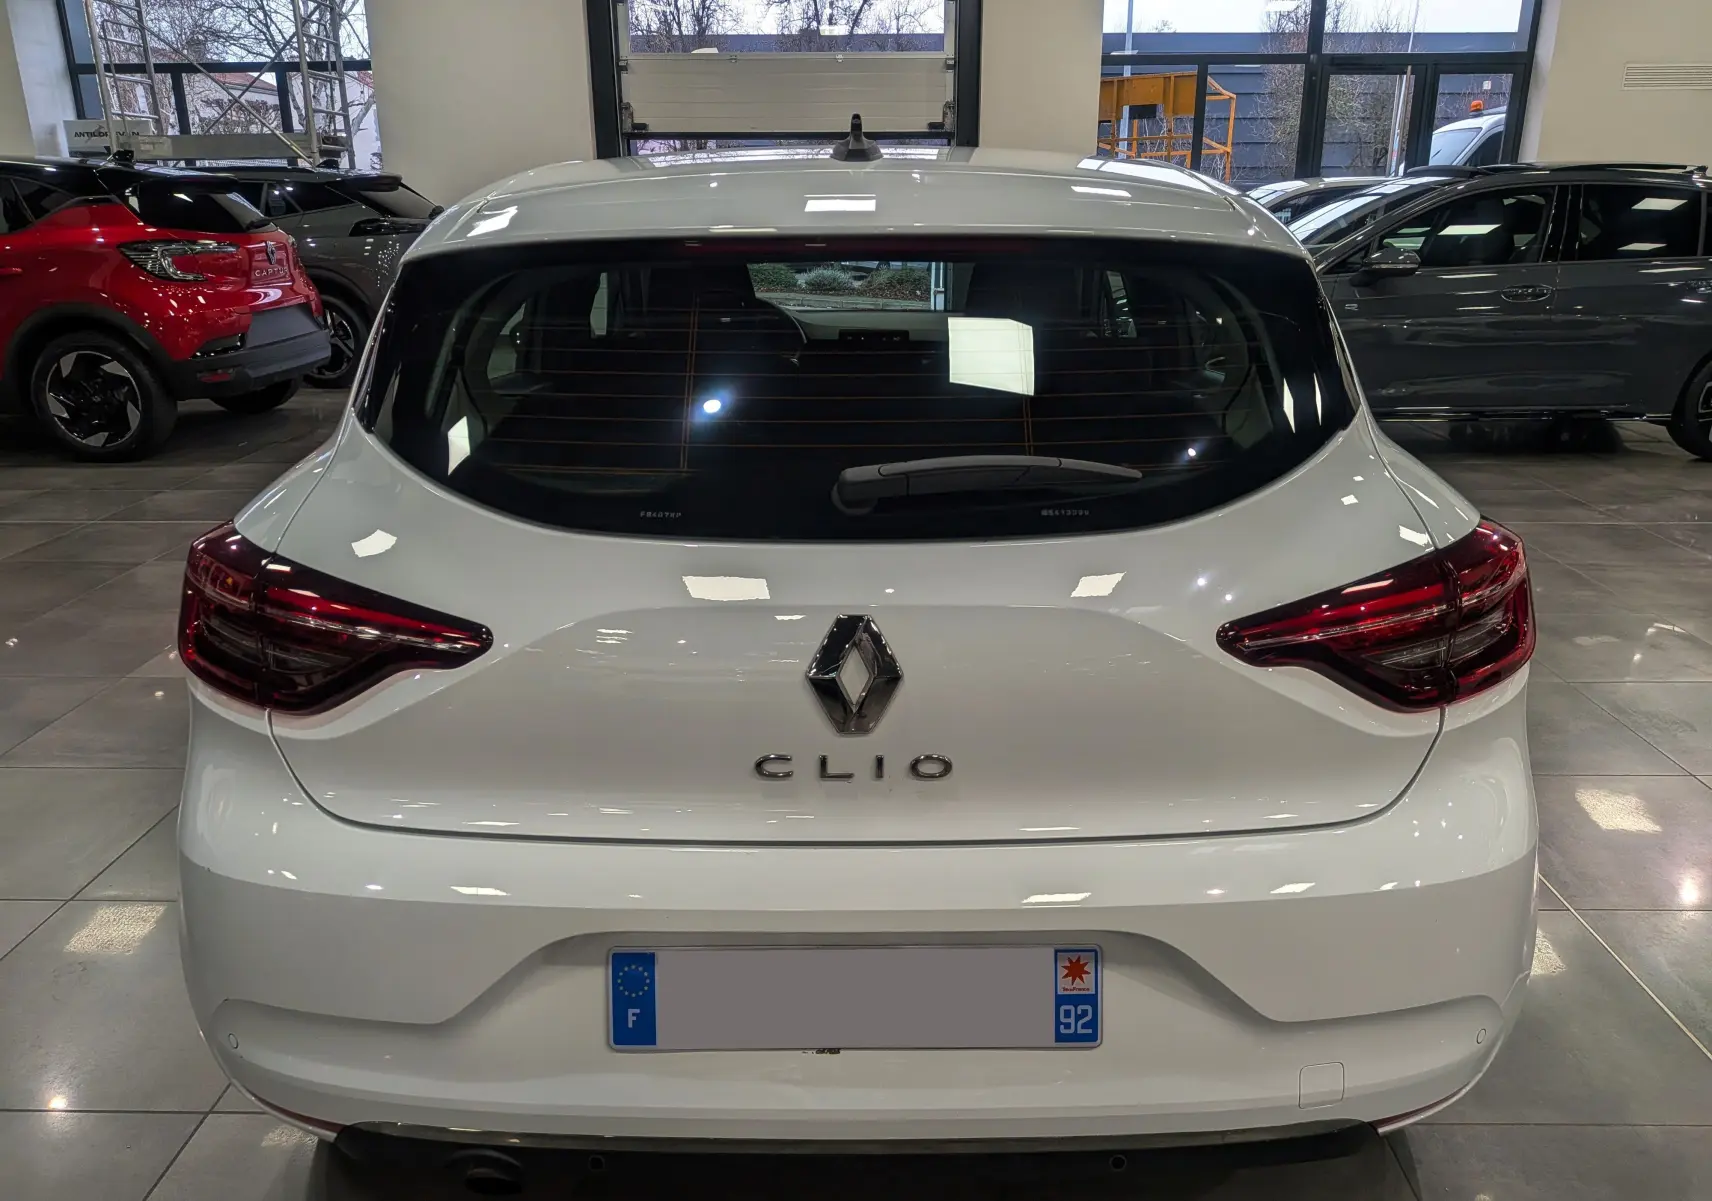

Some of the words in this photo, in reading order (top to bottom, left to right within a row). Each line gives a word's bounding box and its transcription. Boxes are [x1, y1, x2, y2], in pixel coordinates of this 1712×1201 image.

[754, 753, 953, 779] CLIO
[627, 1008, 641, 1029] F
[1059, 1004, 1093, 1034] 92
